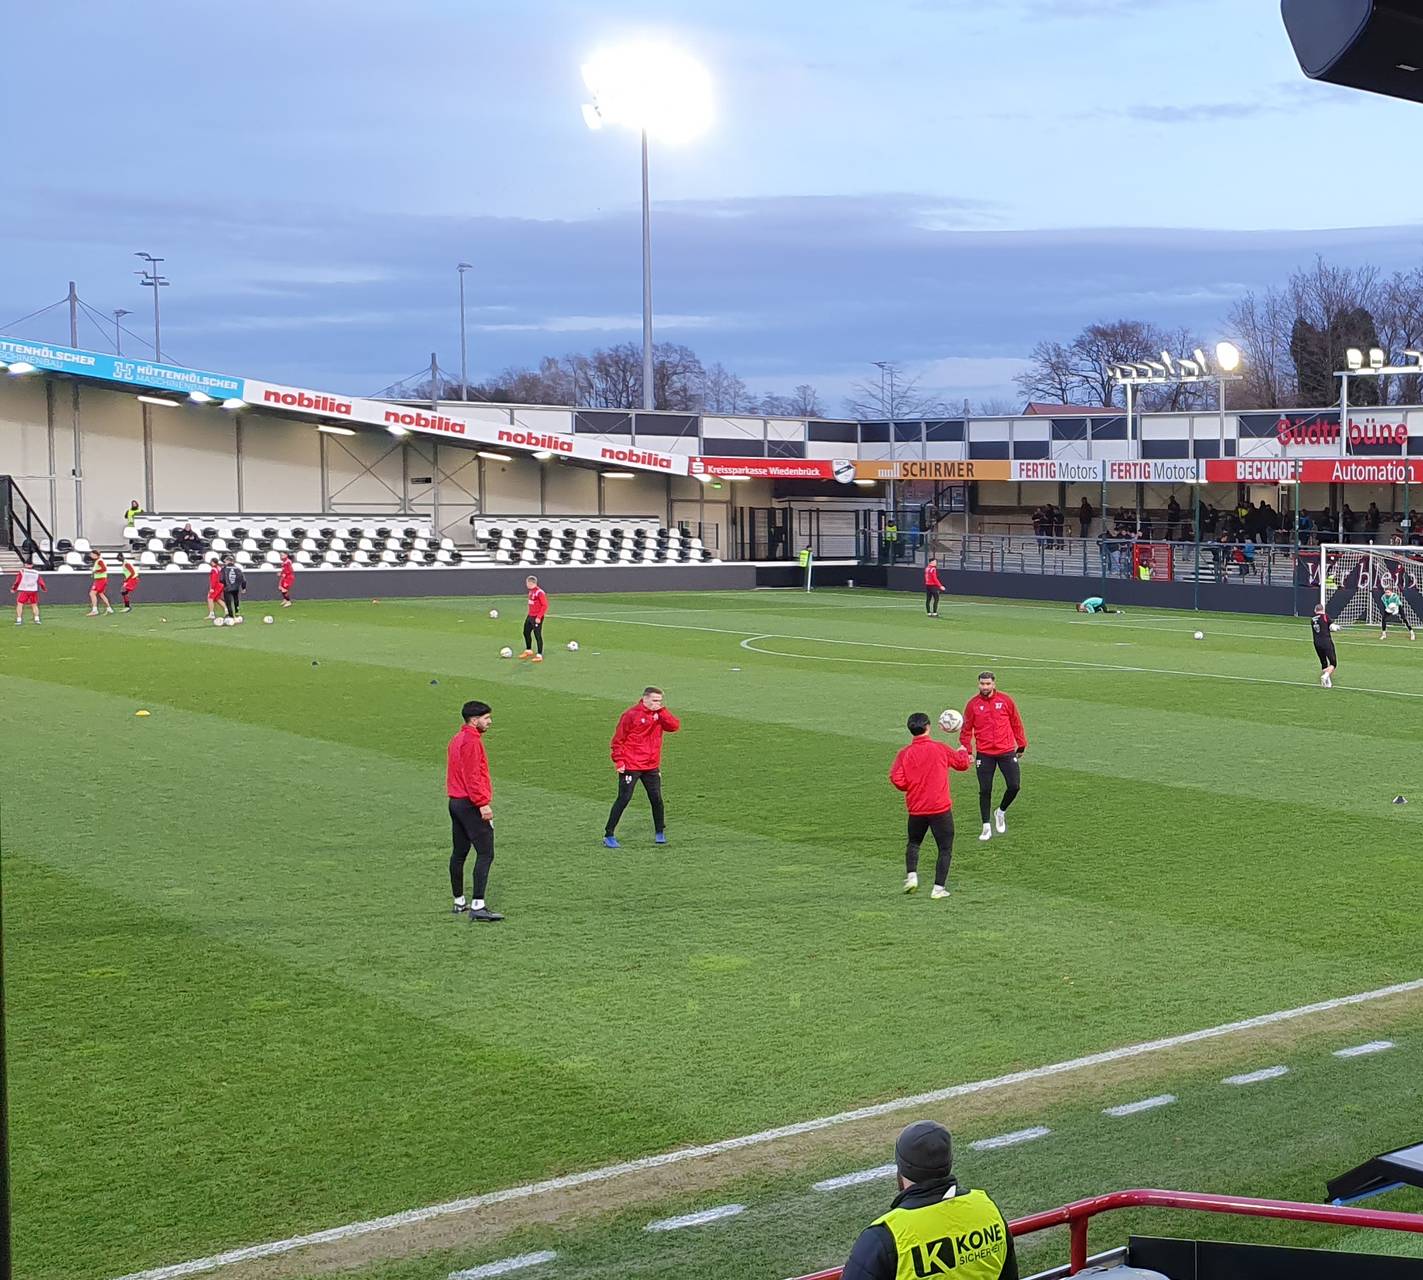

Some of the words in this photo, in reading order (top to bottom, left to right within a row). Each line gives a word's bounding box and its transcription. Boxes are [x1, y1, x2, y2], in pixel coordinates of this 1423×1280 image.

[0, 342, 96, 366] TTENHÖLSCHER
[136, 365, 239, 390] HÜTTENHÖLSCHER
[264, 389, 353, 415] nobilia
[384, 410, 466, 435] nobilia
[1276, 417, 1409, 447] Südtrbüne
[498, 429, 574, 453] nobilia
[600, 446, 673, 470] nobilia
[707, 464, 768, 475] Kreissparkasse
[769, 466, 821, 476] Wiedenbrück
[902, 461, 976, 479] SCHIRMER
[1236, 460, 1303, 480] BECKHOFF
[1018, 462, 1057, 479] FERTIG
[1058, 463, 1098, 480] Motors
[1110, 462, 1151, 480] FERTIG
[1153, 463, 1196, 480] Motors
[1332, 460, 1415, 481] Automation
[955, 1223, 1003, 1255] KONE
[959, 1242, 1004, 1265] SICHEREIT
